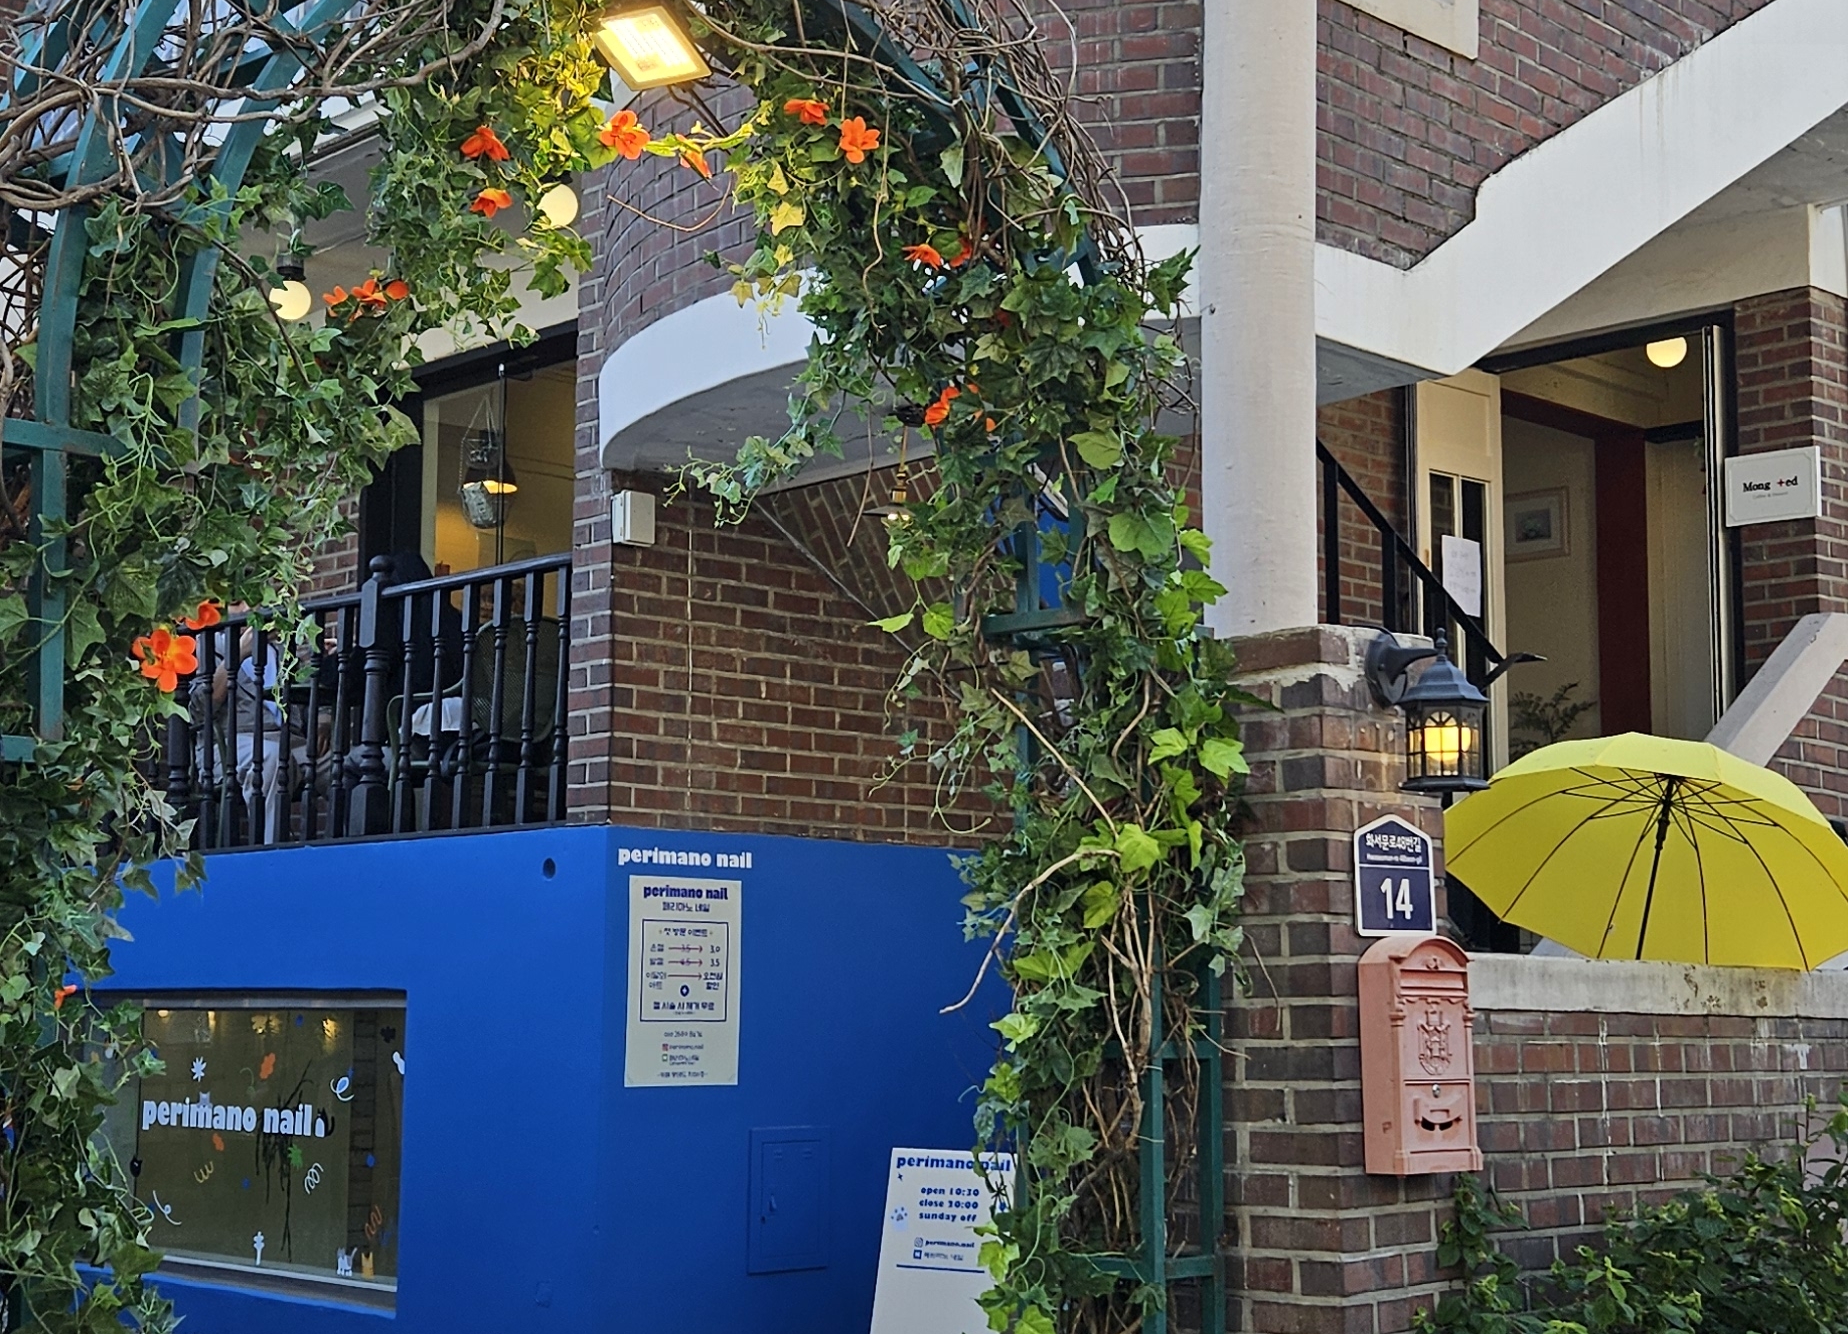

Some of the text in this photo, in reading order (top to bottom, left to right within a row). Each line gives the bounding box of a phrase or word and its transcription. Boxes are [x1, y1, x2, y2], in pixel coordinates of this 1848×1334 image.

[1365, 833, 1422, 853] 화서문로48번길
[617, 847, 753, 868] perimano nail
[643, 885, 729, 900] perimano nail
[1380, 877, 1413, 920] 14
[142, 1097, 312, 1136] perimano nail
[920, 1187, 980, 1197] open 10:30
[919, 1199, 945, 1208] close
[919, 1212, 977, 1223] sunday off
